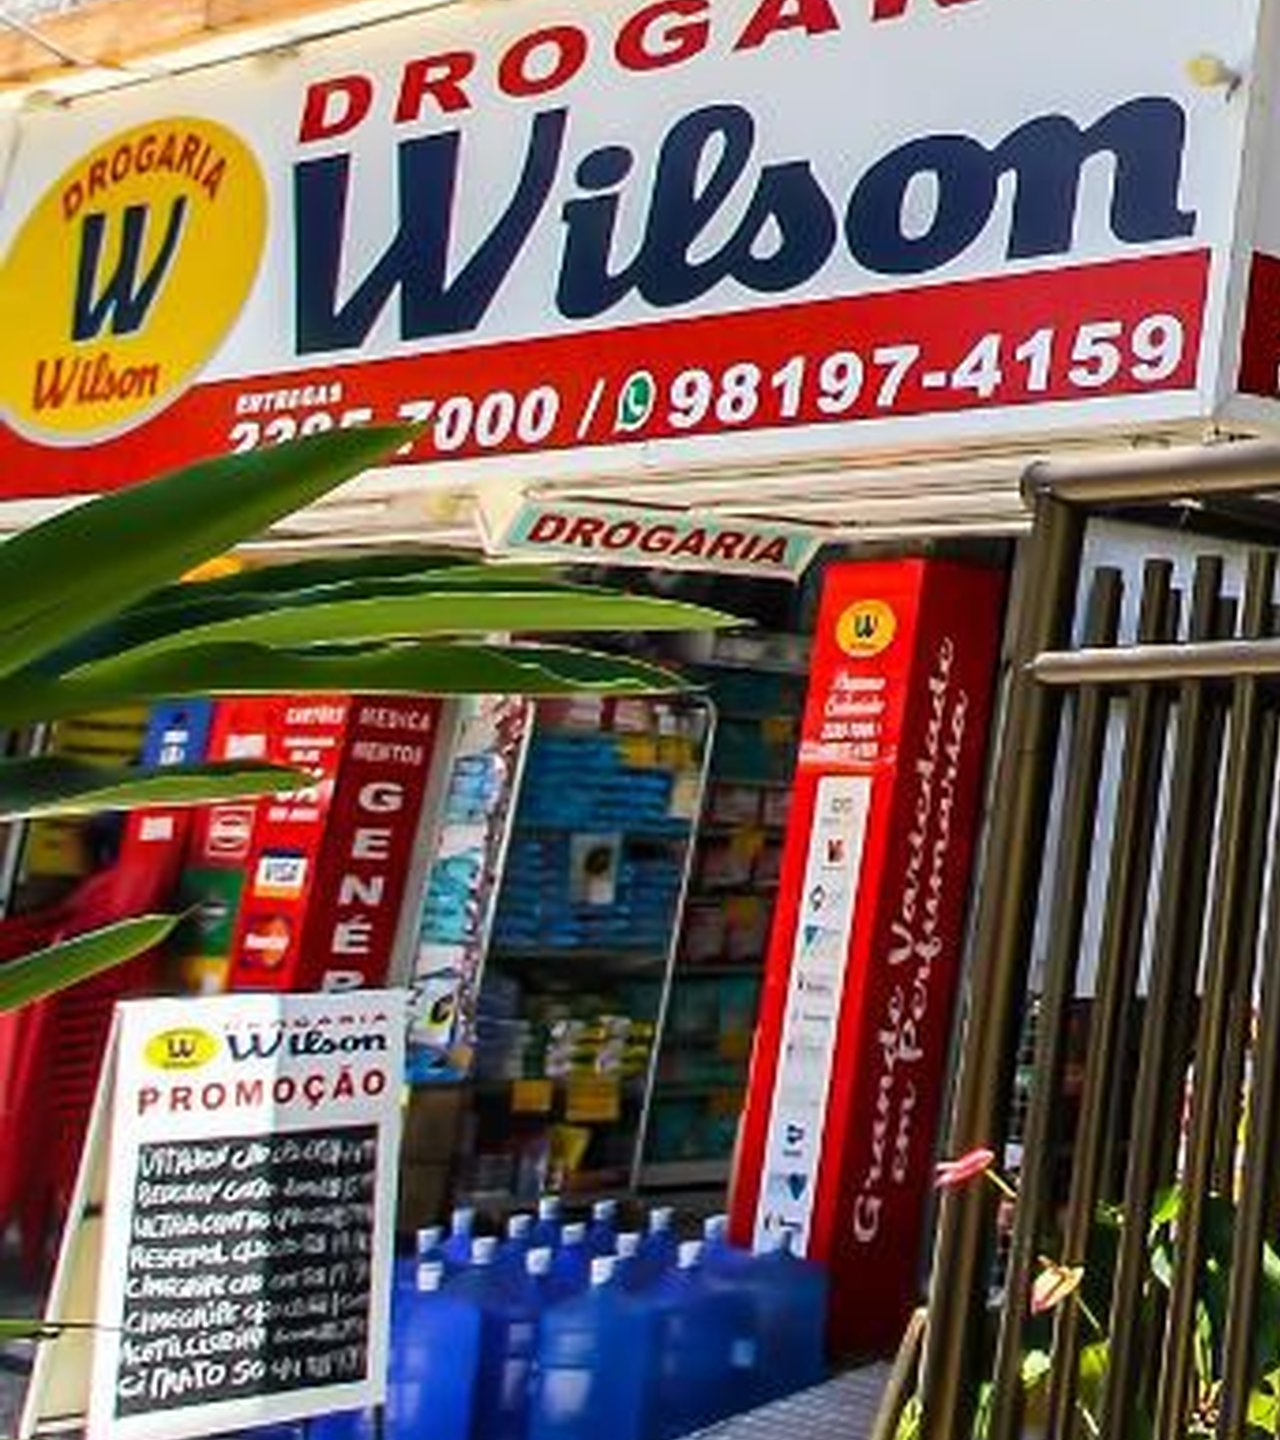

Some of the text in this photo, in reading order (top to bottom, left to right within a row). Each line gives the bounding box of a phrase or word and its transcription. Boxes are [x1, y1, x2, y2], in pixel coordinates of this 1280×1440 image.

[62, 133, 227, 222] DROGARIA
[292, 94, 1197, 358] Wilson
[71, 194, 188, 342] W
[32, 353, 161, 411] Wilson
[235, 382, 343, 416] ENTREGAS
[666, 311, 1187, 429] 98197-4159
[527, 513, 789, 563] DROGARIA
[226, 1028, 387, 1061] Wilson
[137, 1065, 387, 1115] PROMOÇÃO
